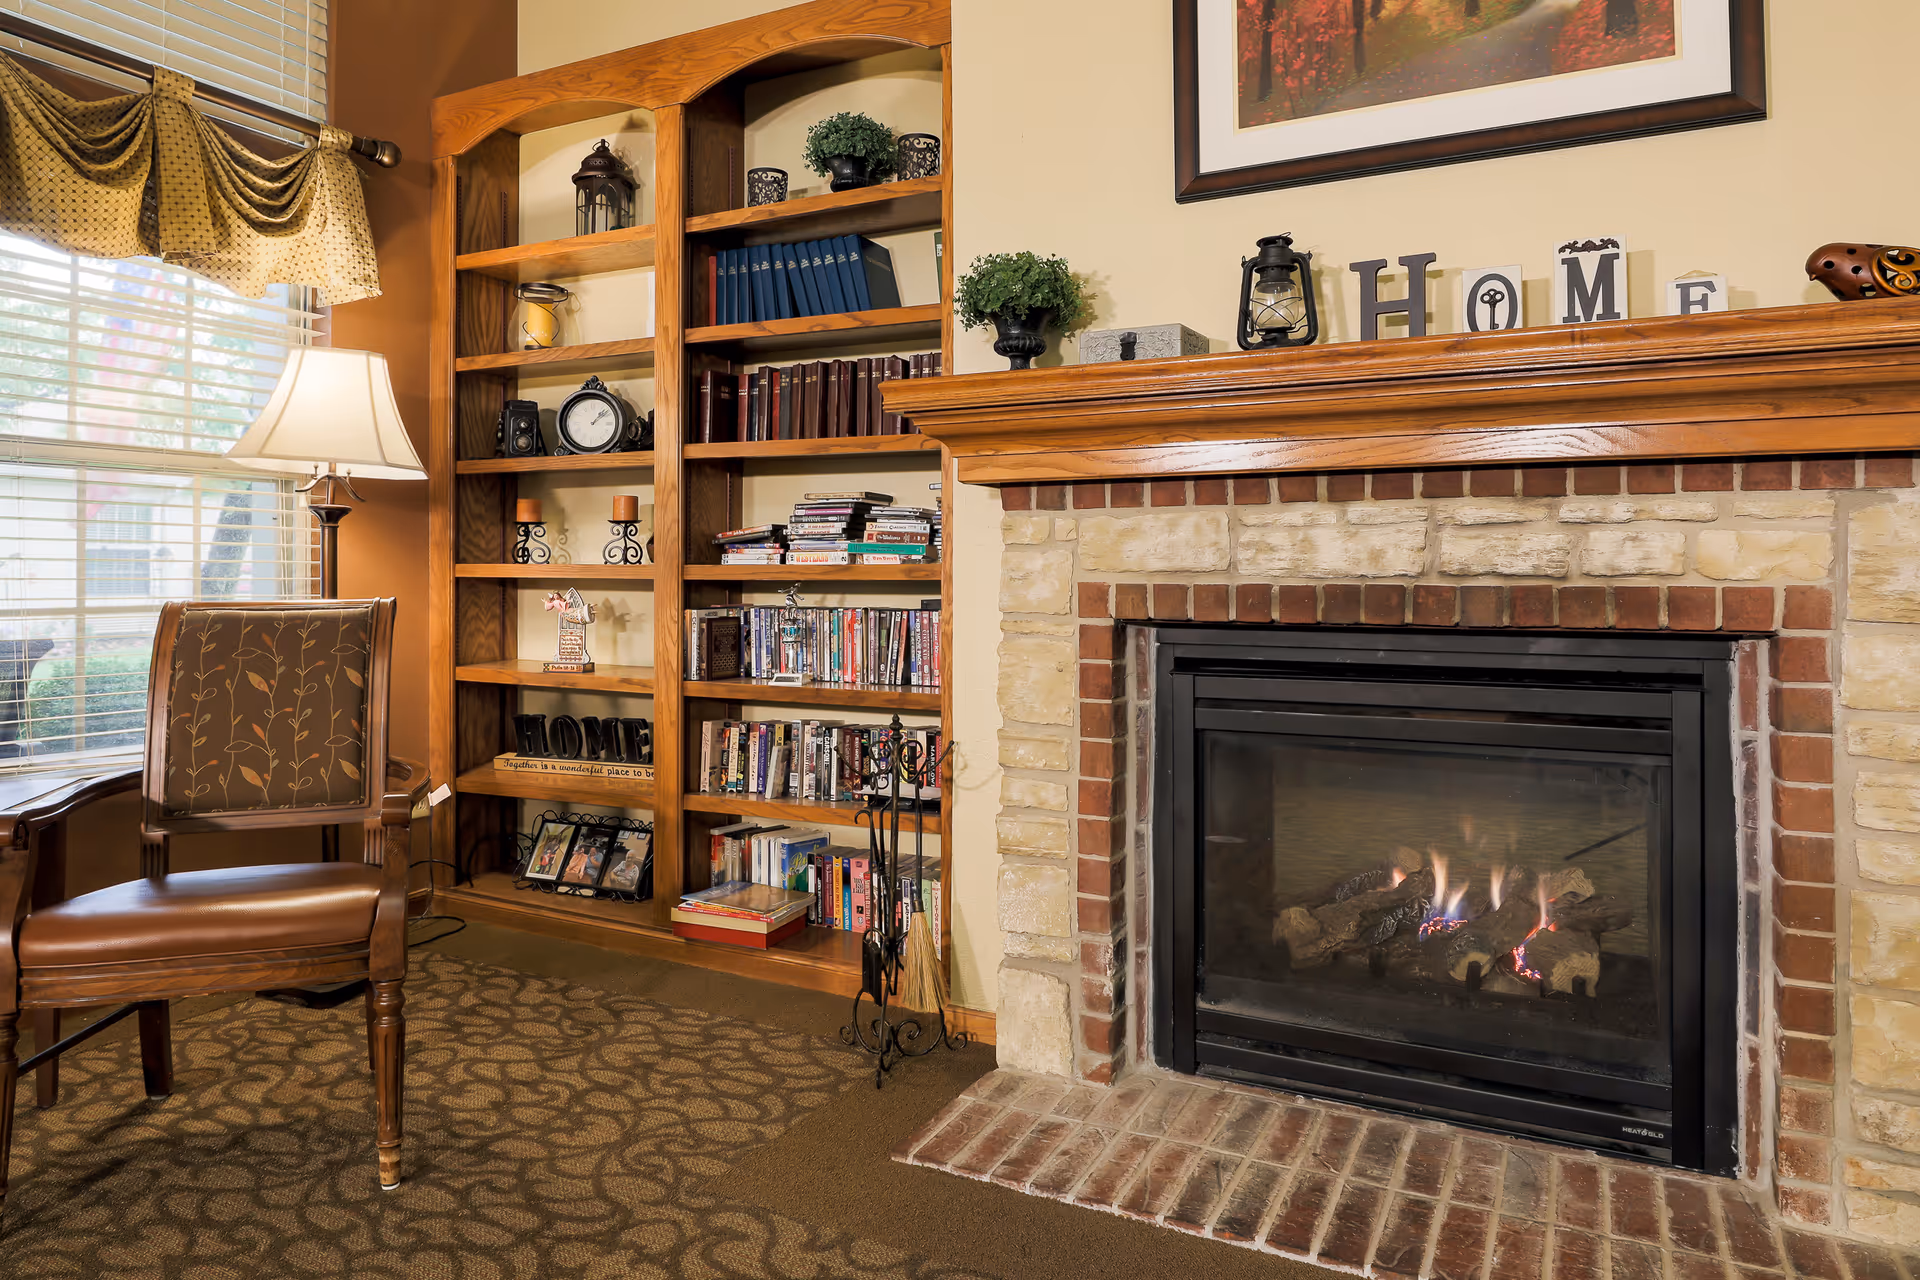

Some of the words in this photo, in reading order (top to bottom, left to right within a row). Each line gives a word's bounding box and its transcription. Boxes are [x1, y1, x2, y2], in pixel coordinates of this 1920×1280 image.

[503, 759, 538, 770] Together
[541, 762, 549, 770] is
[559, 766, 604, 776] wonderful
[607, 767, 630, 777] place
